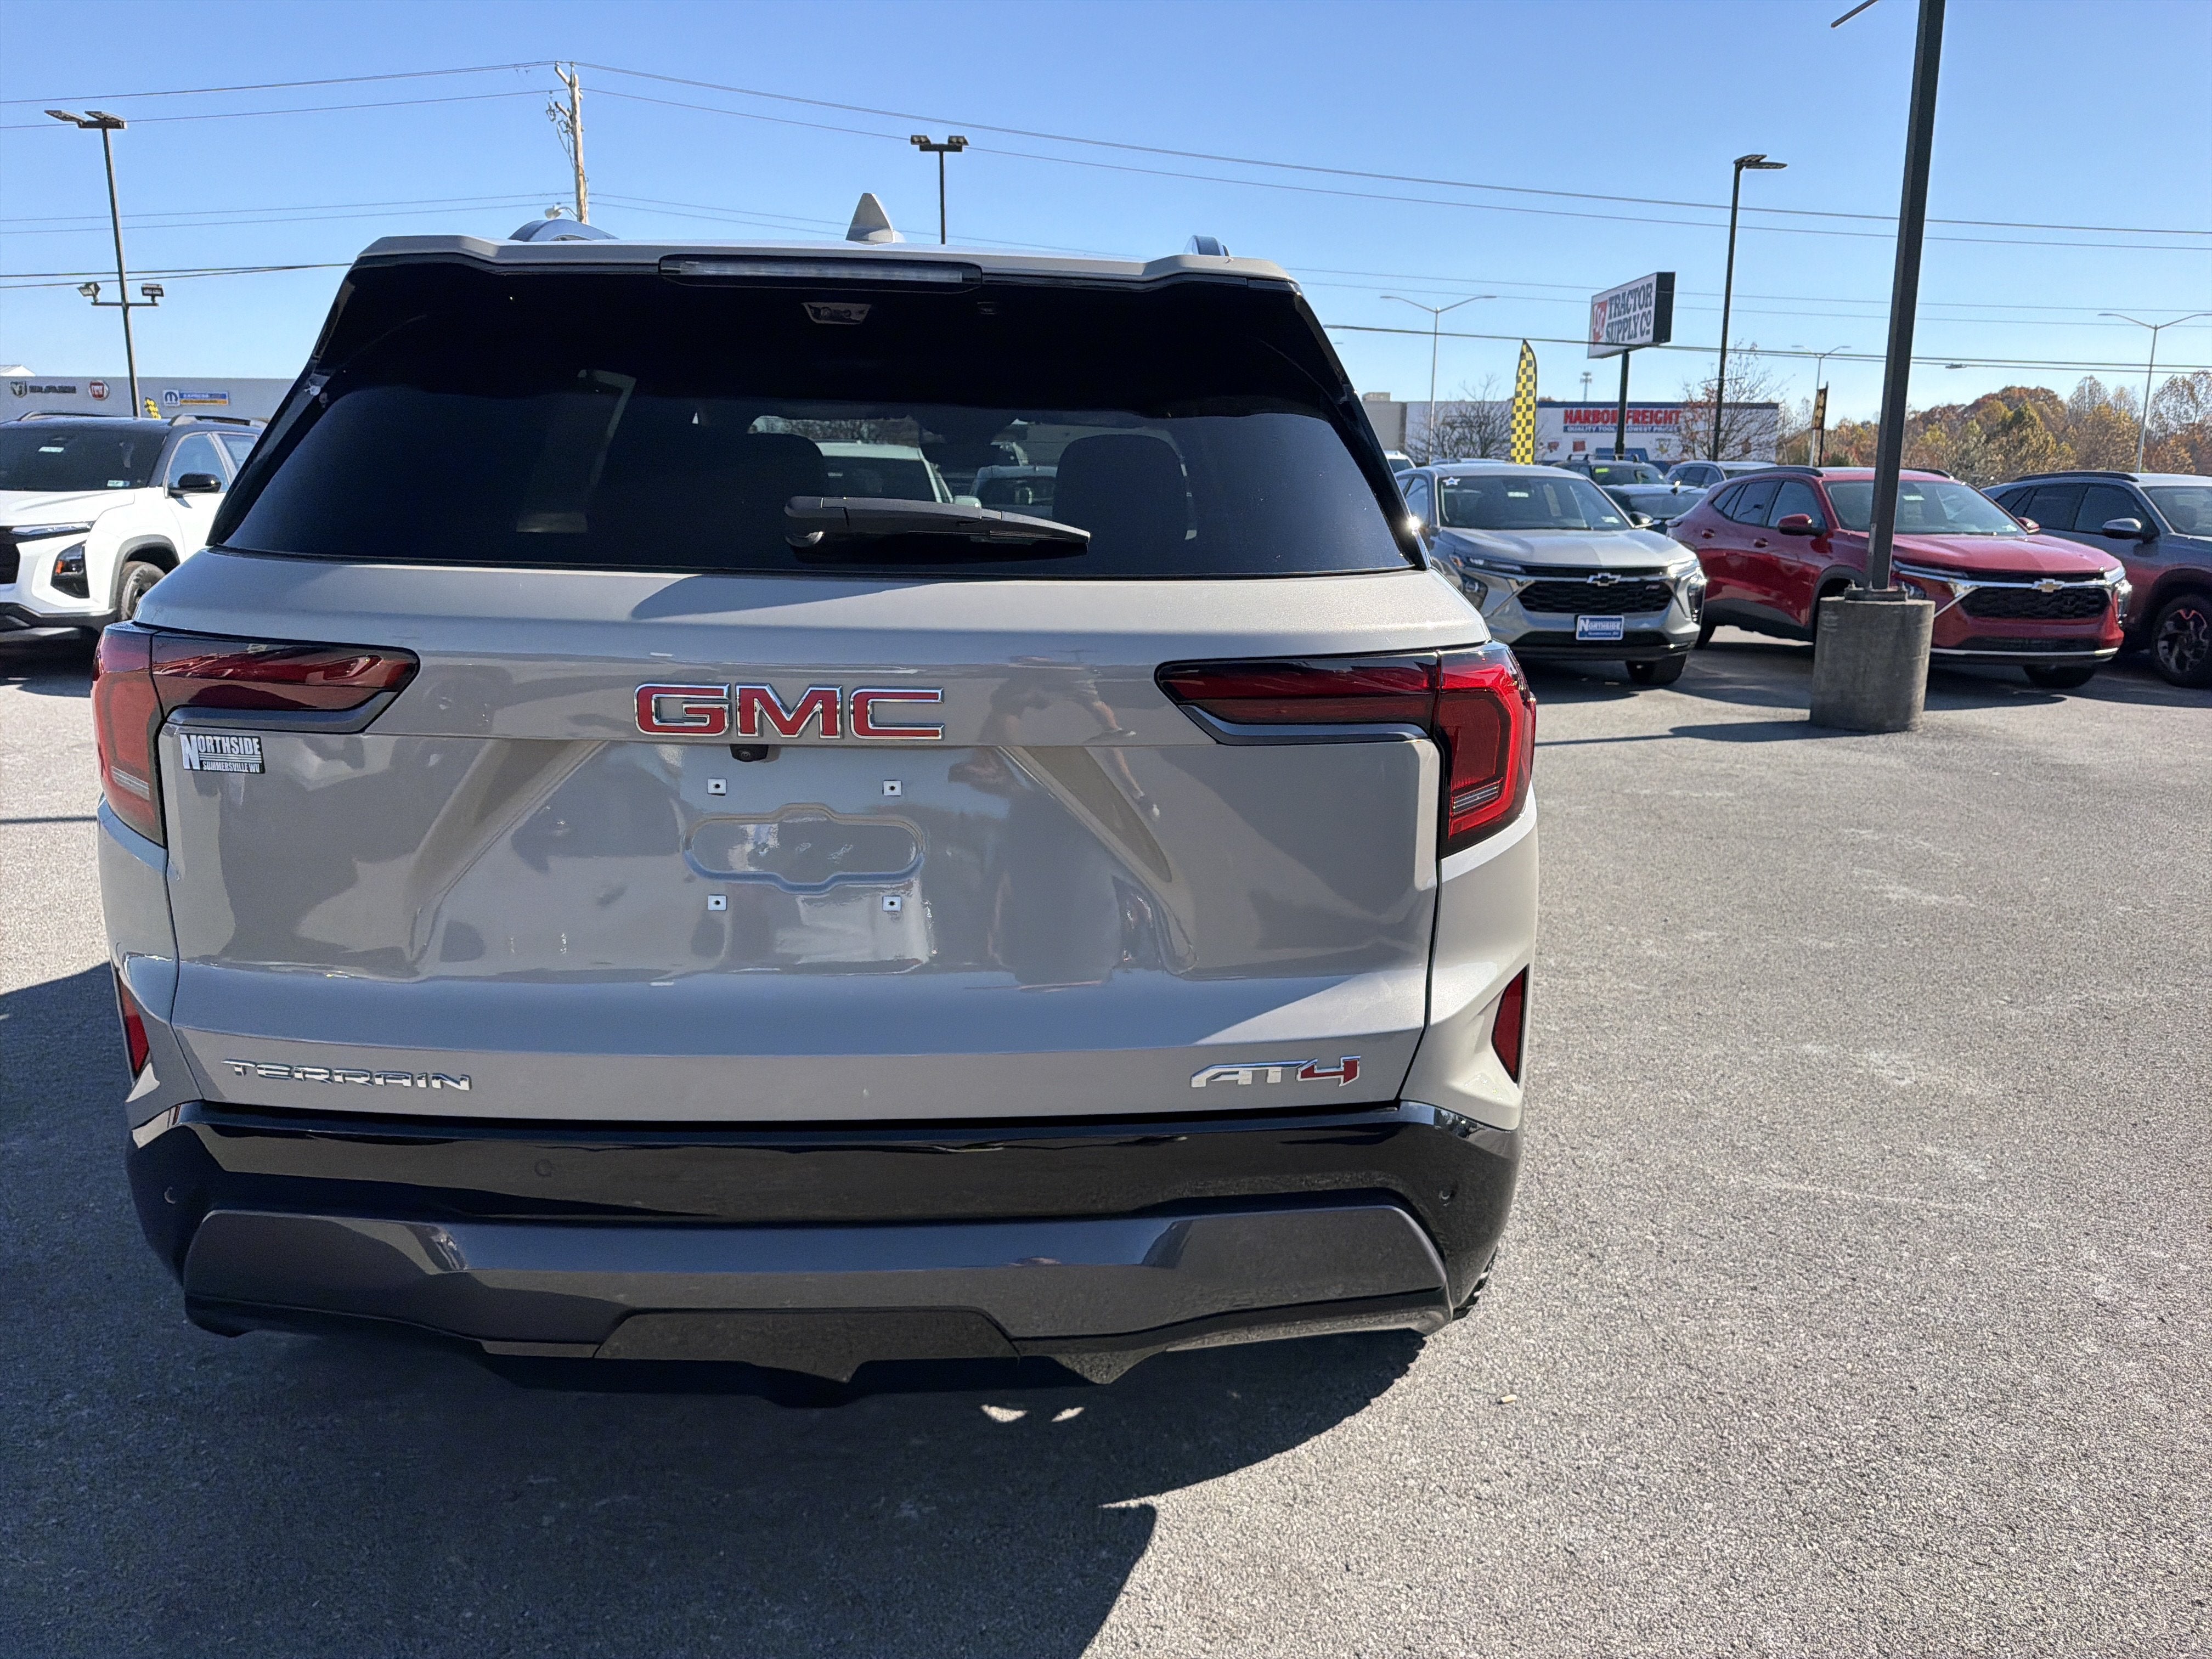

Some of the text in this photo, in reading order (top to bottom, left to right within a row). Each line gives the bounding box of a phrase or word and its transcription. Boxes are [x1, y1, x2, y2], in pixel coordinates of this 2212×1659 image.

[1608, 282, 1653, 321] TRACTOR
[1606, 313, 1640, 343] SUPPLY
[1626, 410, 1682, 424] FREIGHT
[634, 684, 945, 740] GMC
[180, 734, 261, 770] NORTHSIDE
[202, 760, 260, 773] SUMMERSVILLE WV
[221, 1058, 472, 1091] TERRAIN
[1190, 1055, 1361, 1088] AT4
